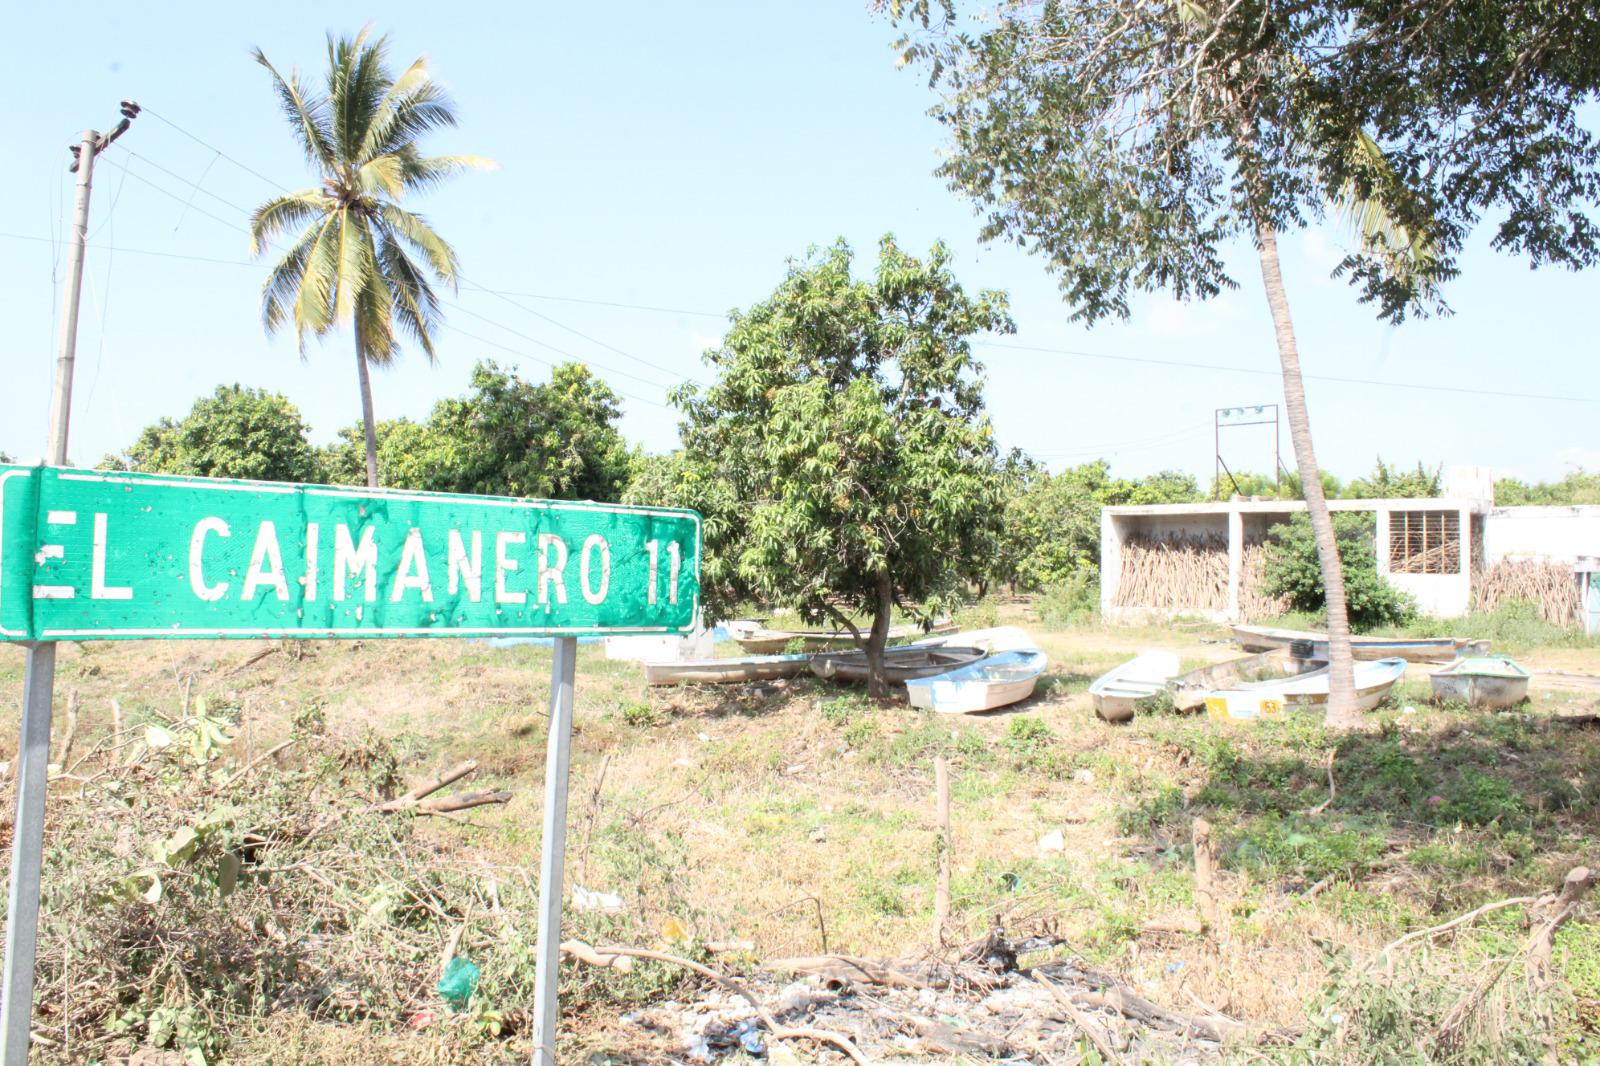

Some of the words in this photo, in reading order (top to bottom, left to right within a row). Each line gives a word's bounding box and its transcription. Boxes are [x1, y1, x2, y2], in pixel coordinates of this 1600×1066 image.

[33, 510, 134, 600] EL
[188, 516, 611, 606] CAIMANERO
[645, 538, 681, 606] 11
